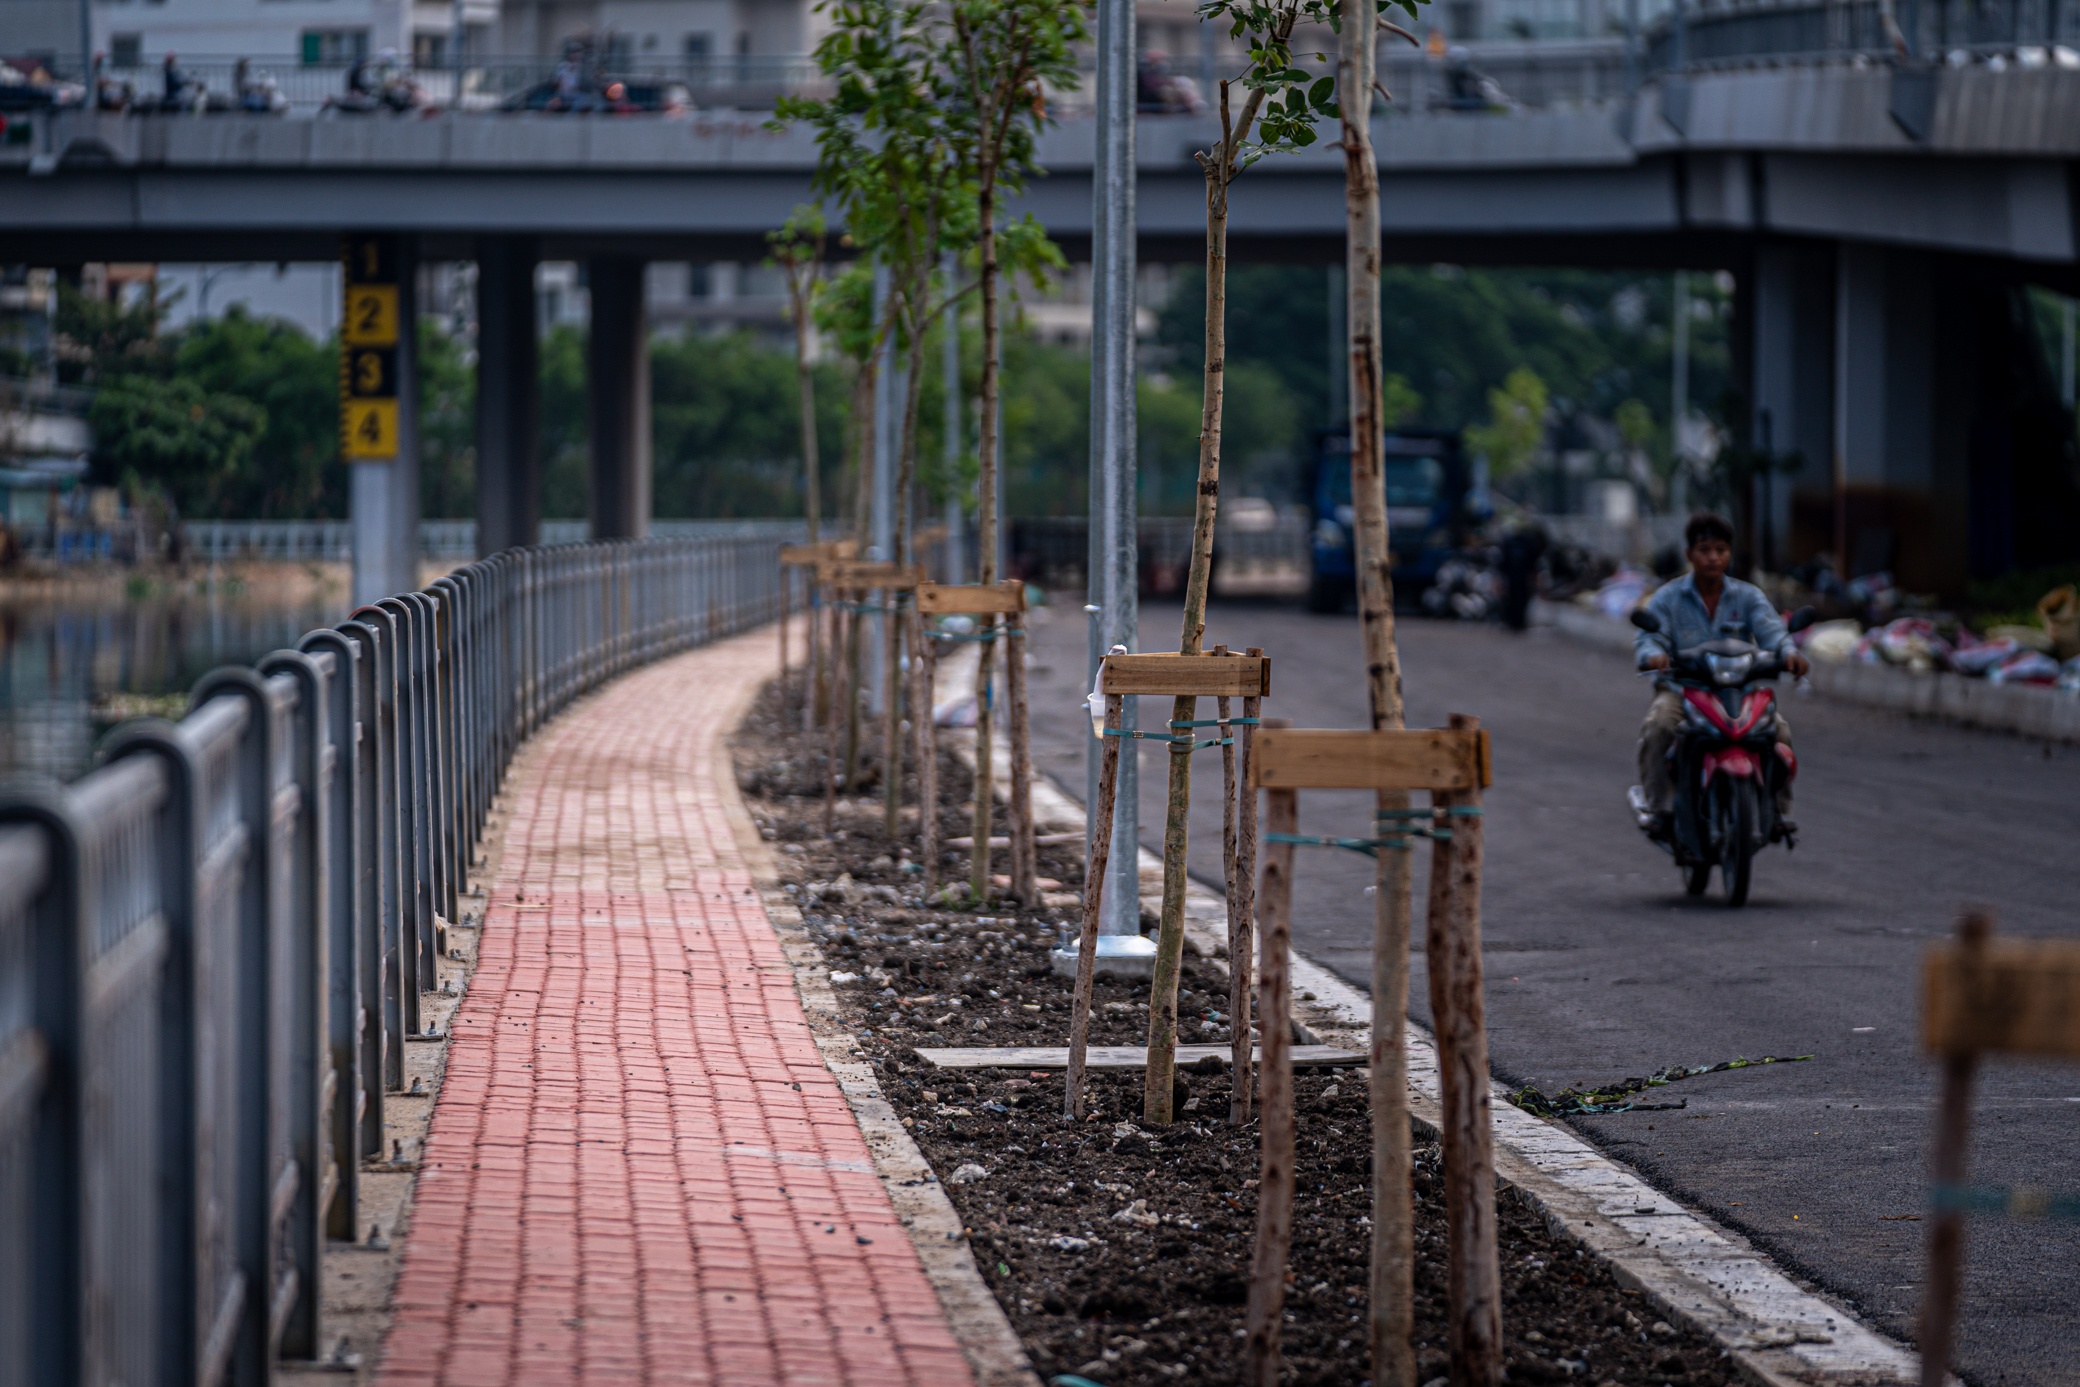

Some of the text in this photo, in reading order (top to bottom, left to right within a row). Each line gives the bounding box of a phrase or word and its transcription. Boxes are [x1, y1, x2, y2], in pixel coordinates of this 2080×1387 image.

[363, 242, 379, 277] 1
[358, 296, 381, 331] 2
[358, 353, 383, 392] 3
[358, 408, 381, 444] 4
